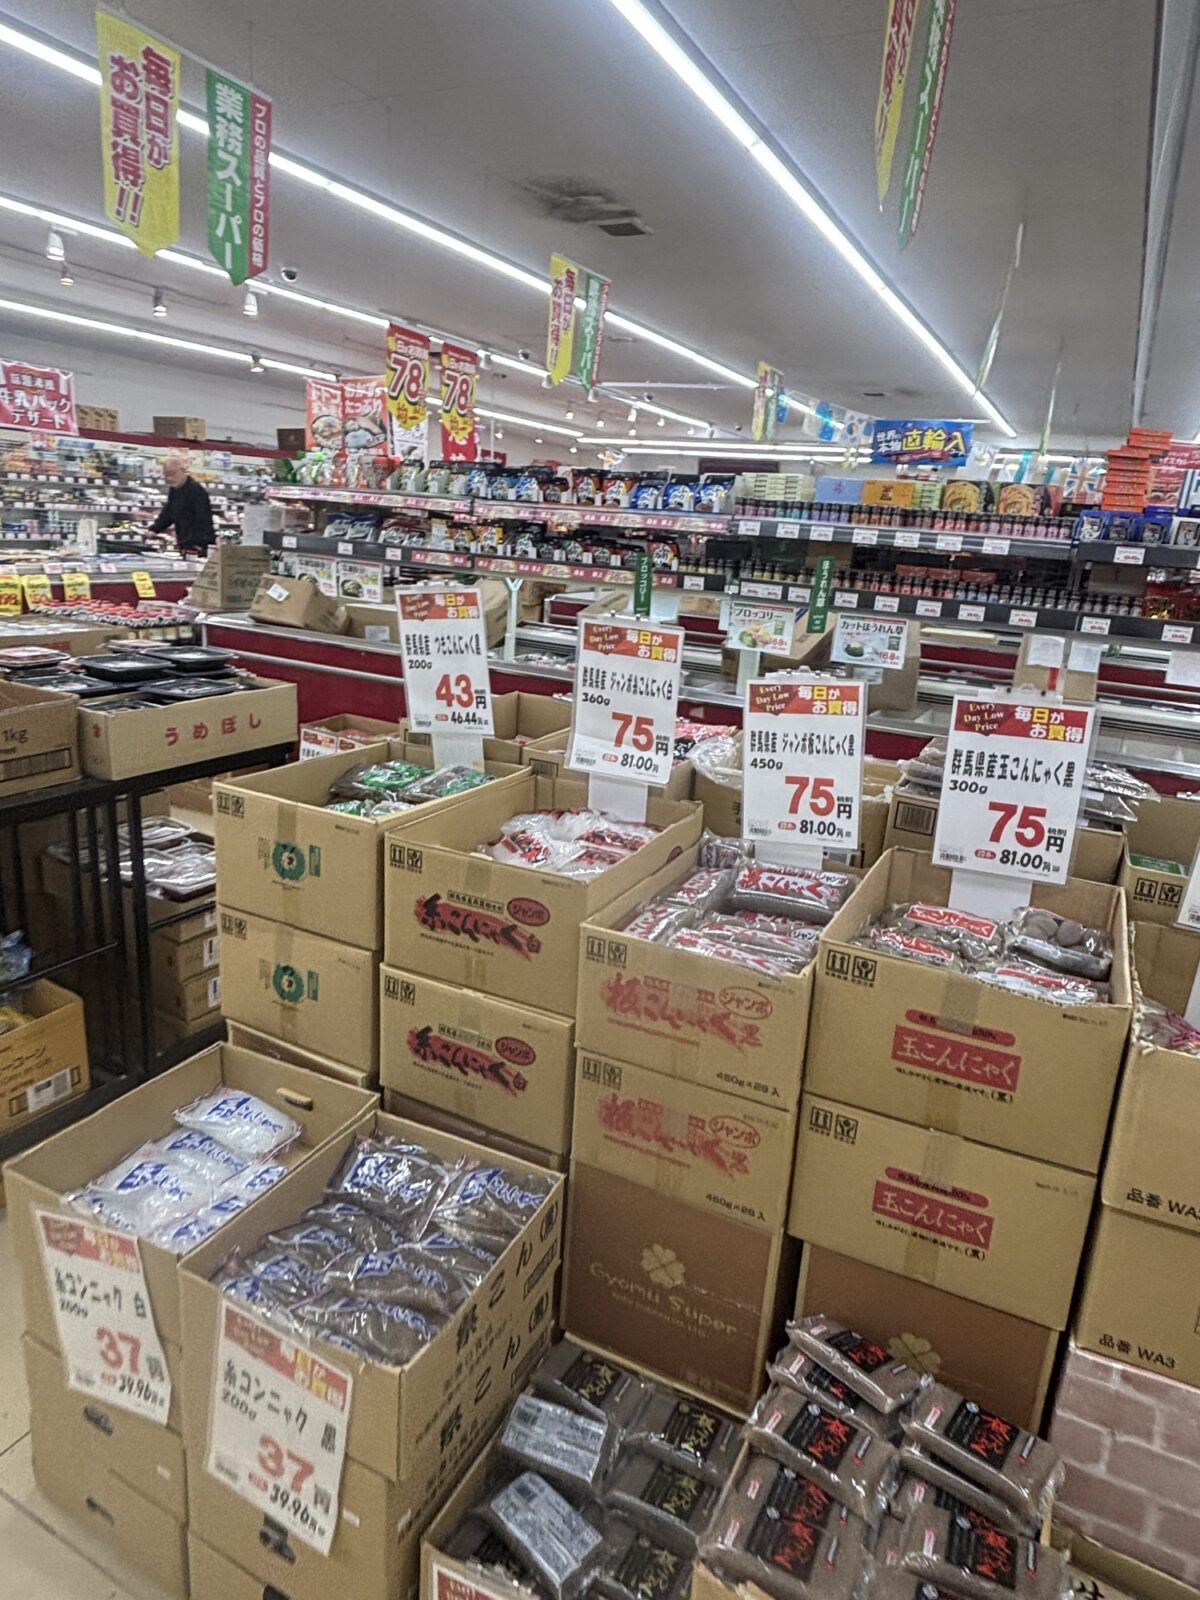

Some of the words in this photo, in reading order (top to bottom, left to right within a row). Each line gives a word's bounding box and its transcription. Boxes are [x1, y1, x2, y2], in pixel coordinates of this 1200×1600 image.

[142, 46, 170, 168] 毎日が
[215, 82, 243, 269] 業務スーパー
[389, 353, 424, 403] 78
[443, 370, 472, 414] 78
[902, 429, 966, 452] 直輸入
[735, 606, 783, 620] ブロッコリー
[841, 620, 903, 635] カットほうれん草
[435, 673, 474, 708] 43
[475, 695, 487, 709] 円
[798, 685, 840, 700] 毎日が
[812, 701, 857, 716] お買得
[964, 713, 981, 723] Day
[984, 710, 1004, 720] Low
[969, 703, 996, 712] Every
[1015, 706, 1064, 724] 毎日が
[165, 713, 261, 746] うめぼし
[612, 712, 654, 752] 75
[975, 722, 999, 731] Price
[1029, 724, 1083, 742] お買得
[656, 741, 669, 756] 円
[785, 776, 835, 816] 75
[837, 803, 852, 820] 円
[988, 801, 1047, 848] 75
[1046, 835, 1065, 853] 円
[896, 1035, 1015, 1086] 玉こんにゃく
[1127, 1187, 1163, 1209] 品番
[876, 1191, 986, 1244] 玉こんにゃく
[97, 1327, 141, 1374] 37
[1099, 1333, 1132, 1354] 品番
[1137, 1346, 1176, 1369] WA3
[258, 1434, 315, 1494] 37
